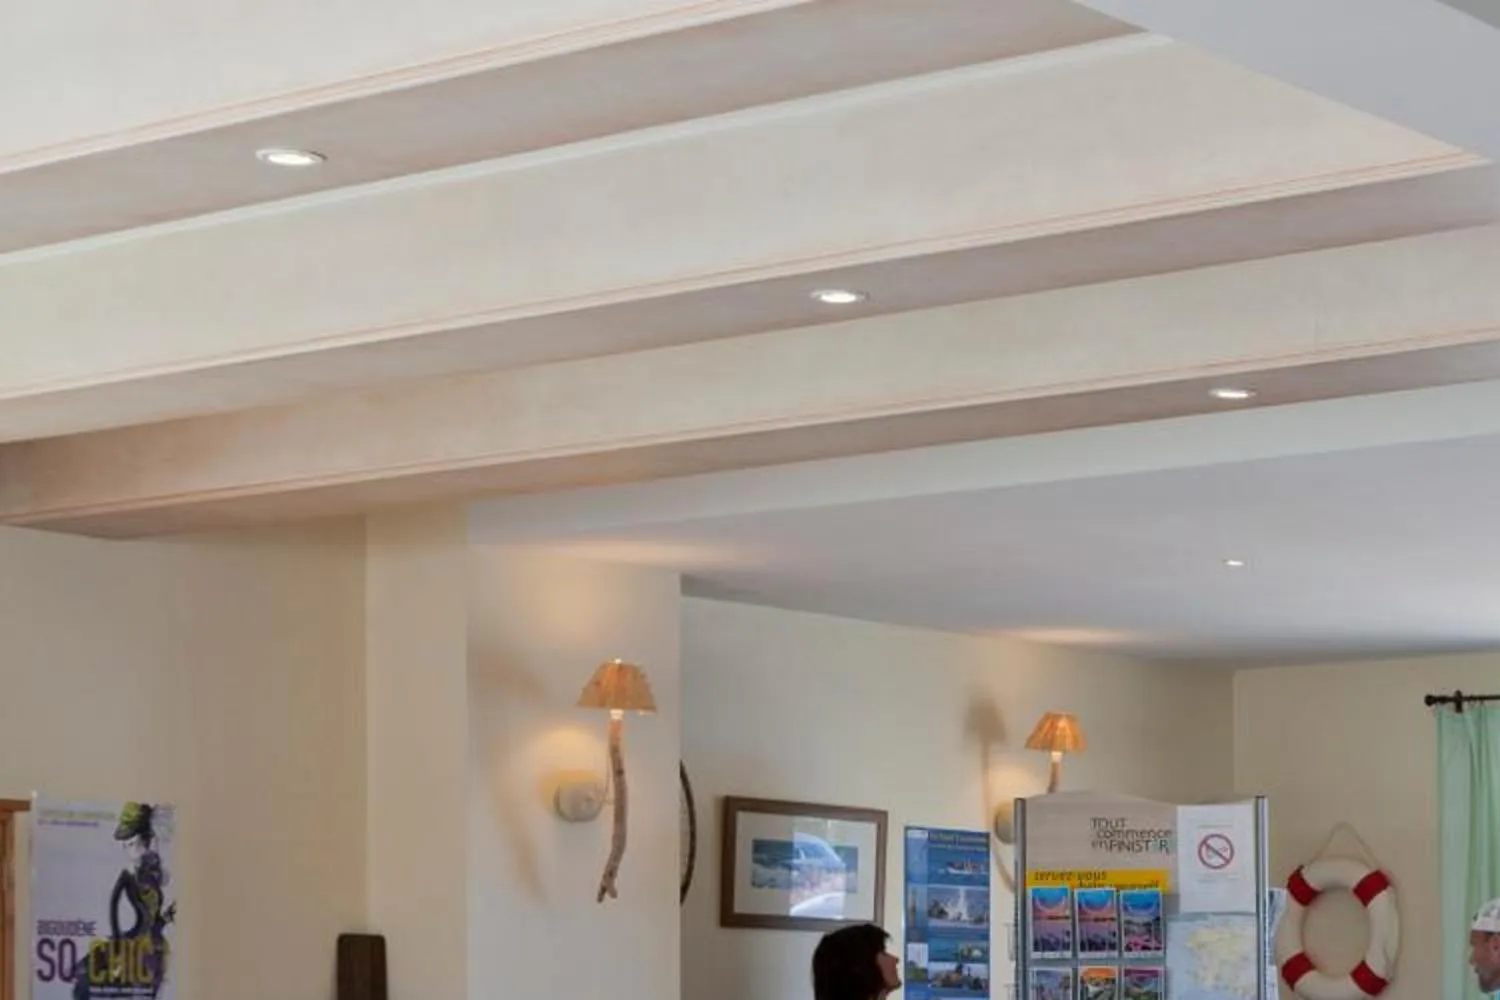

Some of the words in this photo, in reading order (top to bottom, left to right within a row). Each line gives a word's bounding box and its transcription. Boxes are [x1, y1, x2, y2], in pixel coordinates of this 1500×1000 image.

[1090, 816, 1127, 829] TOUT
[1096, 828, 1174, 840] commence
[36, 937, 77, 983] SO
[89, 936, 154, 984] CHIC
